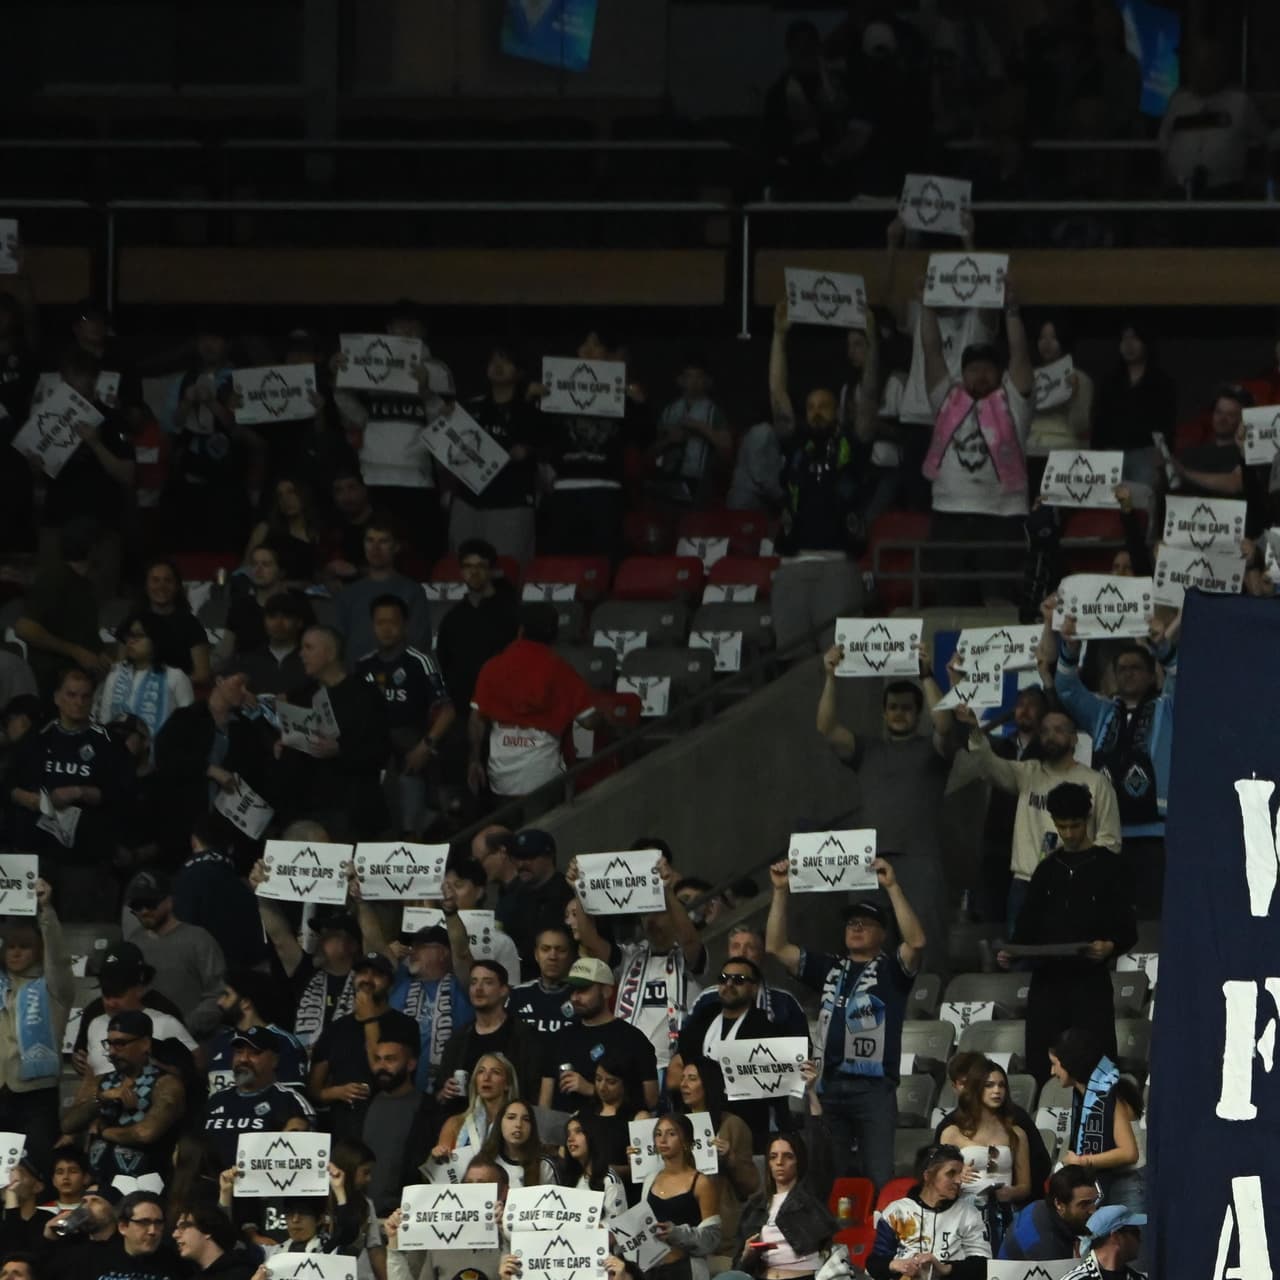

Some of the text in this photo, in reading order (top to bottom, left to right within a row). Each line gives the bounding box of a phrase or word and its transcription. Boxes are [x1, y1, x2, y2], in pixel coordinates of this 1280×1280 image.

[1082, 602, 1138, 614] SAVE THE CAPS
[850, 642, 904, 652] SAVE THE CAPS
[46, 761, 91, 777] ELUS
[803, 855, 859, 867] SAVE THE CAPS
[277, 865, 333, 878] SAVE THE CAPS
[370, 865, 429, 875] SAVE THE CAPS
[590, 876, 646, 890] SAVE THE CAPS
[853, 1037, 876, 1058] 19
[737, 1063, 794, 1075] SAVE THE CAPS
[205, 1118, 264, 1129] TELUS
[251, 1159, 312, 1170] SAVE THE CAPS
[416, 1211, 479, 1222] SAVE THE CAPS
